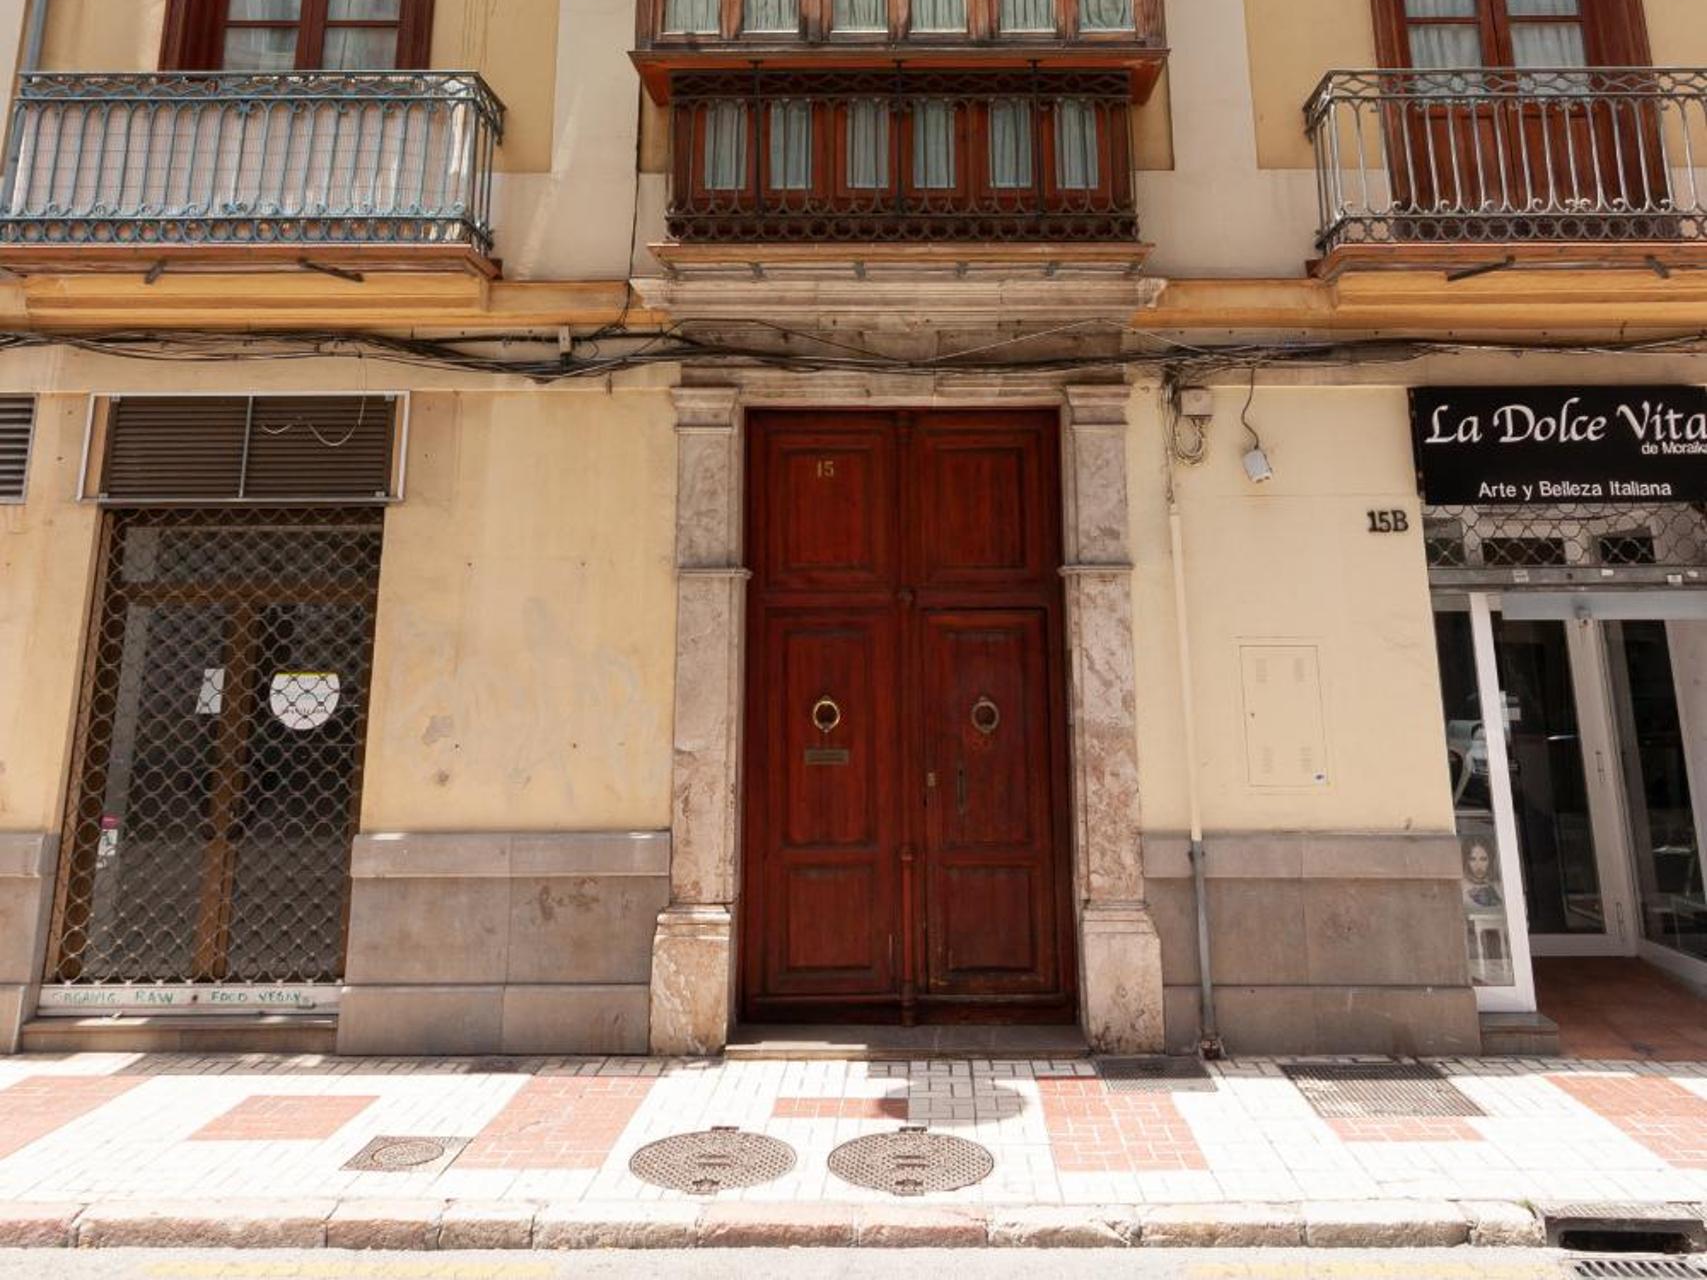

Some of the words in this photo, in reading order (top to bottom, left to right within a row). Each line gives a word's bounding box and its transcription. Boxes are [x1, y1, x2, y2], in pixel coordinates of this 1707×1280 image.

[1425, 405, 1482, 443] La
[1493, 397, 1607, 443] Dolce
[1616, 401, 1707, 441] Vita
[1641, 440, 1658, 455] de
[816, 460, 834, 478] 15
[1478, 482, 1517, 499] Arte
[1522, 485, 1533, 500] y
[1539, 481, 1602, 497] Belleza
[1609, 480, 1672, 497] Italiana
[1366, 510, 1409, 533] 15B
[136, 991, 174, 1004] RAW
